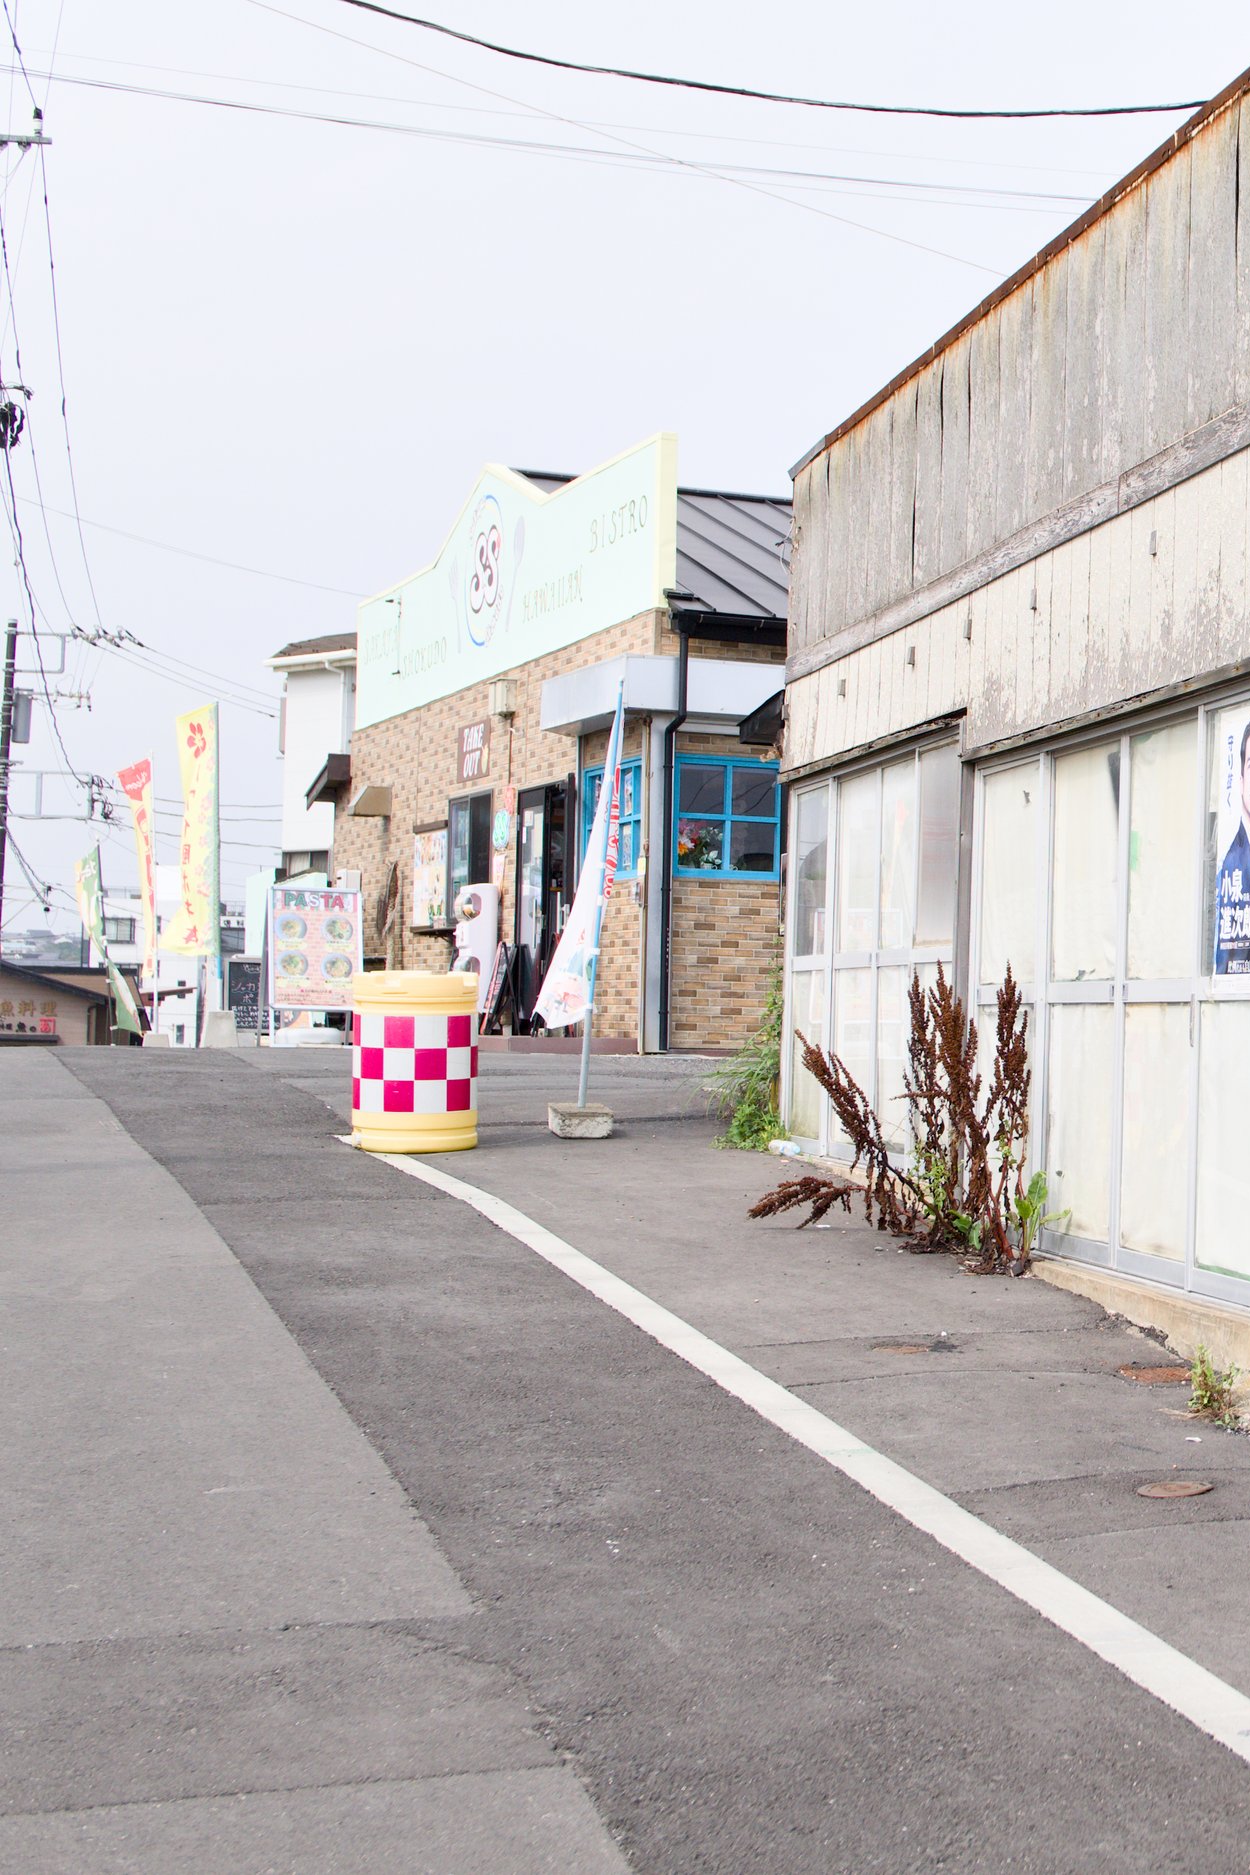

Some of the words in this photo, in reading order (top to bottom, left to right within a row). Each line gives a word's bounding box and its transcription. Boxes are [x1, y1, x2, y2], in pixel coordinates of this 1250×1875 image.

[589, 494, 648, 553] BISTRO
[522, 564, 583, 624] HAWAIIAN
[401, 636, 447, 680] SHOKUDO
[463, 723, 485, 752] TAKE
[463, 751, 480, 778] OUT
[284, 891, 344, 909] PASTA
[1221, 869, 1243, 903] 小泉
